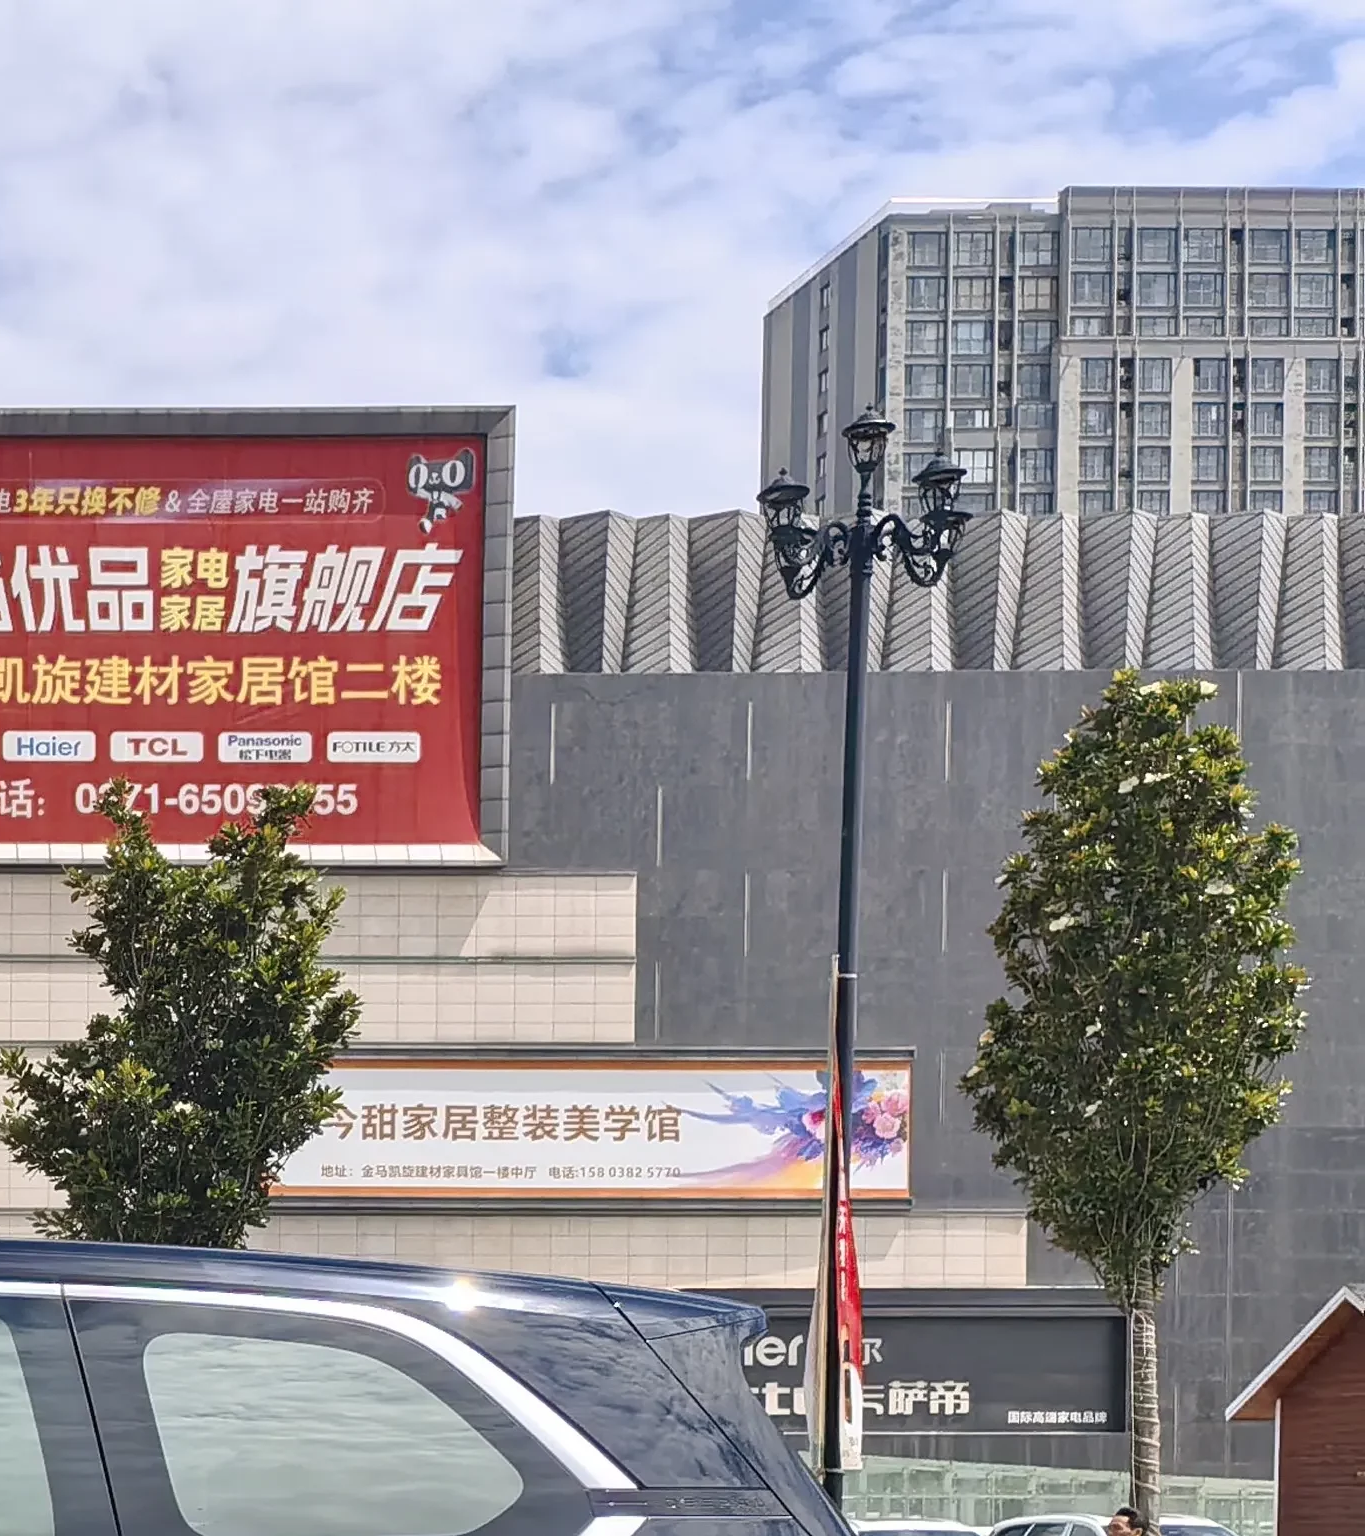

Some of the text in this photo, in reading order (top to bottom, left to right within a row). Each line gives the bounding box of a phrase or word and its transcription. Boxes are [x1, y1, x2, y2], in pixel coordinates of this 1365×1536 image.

[186, 488, 375, 515] 全屋家电一站购齐
[160, 546, 230, 590] 家电
[226, 541, 464, 633] 旗舰店
[160, 594, 227, 633] 家居
[16, 735, 82, 757] Haier
[126, 737, 188, 757] TCL
[227, 734, 303, 748] Panasonic
[332, 740, 416, 754] FOTILE 方太
[239, 748, 292, 761] 松下电器
[608, 1166, 642, 1179] 0382
[1007, 1410, 1108, 1425] 国际高端家电品牌
